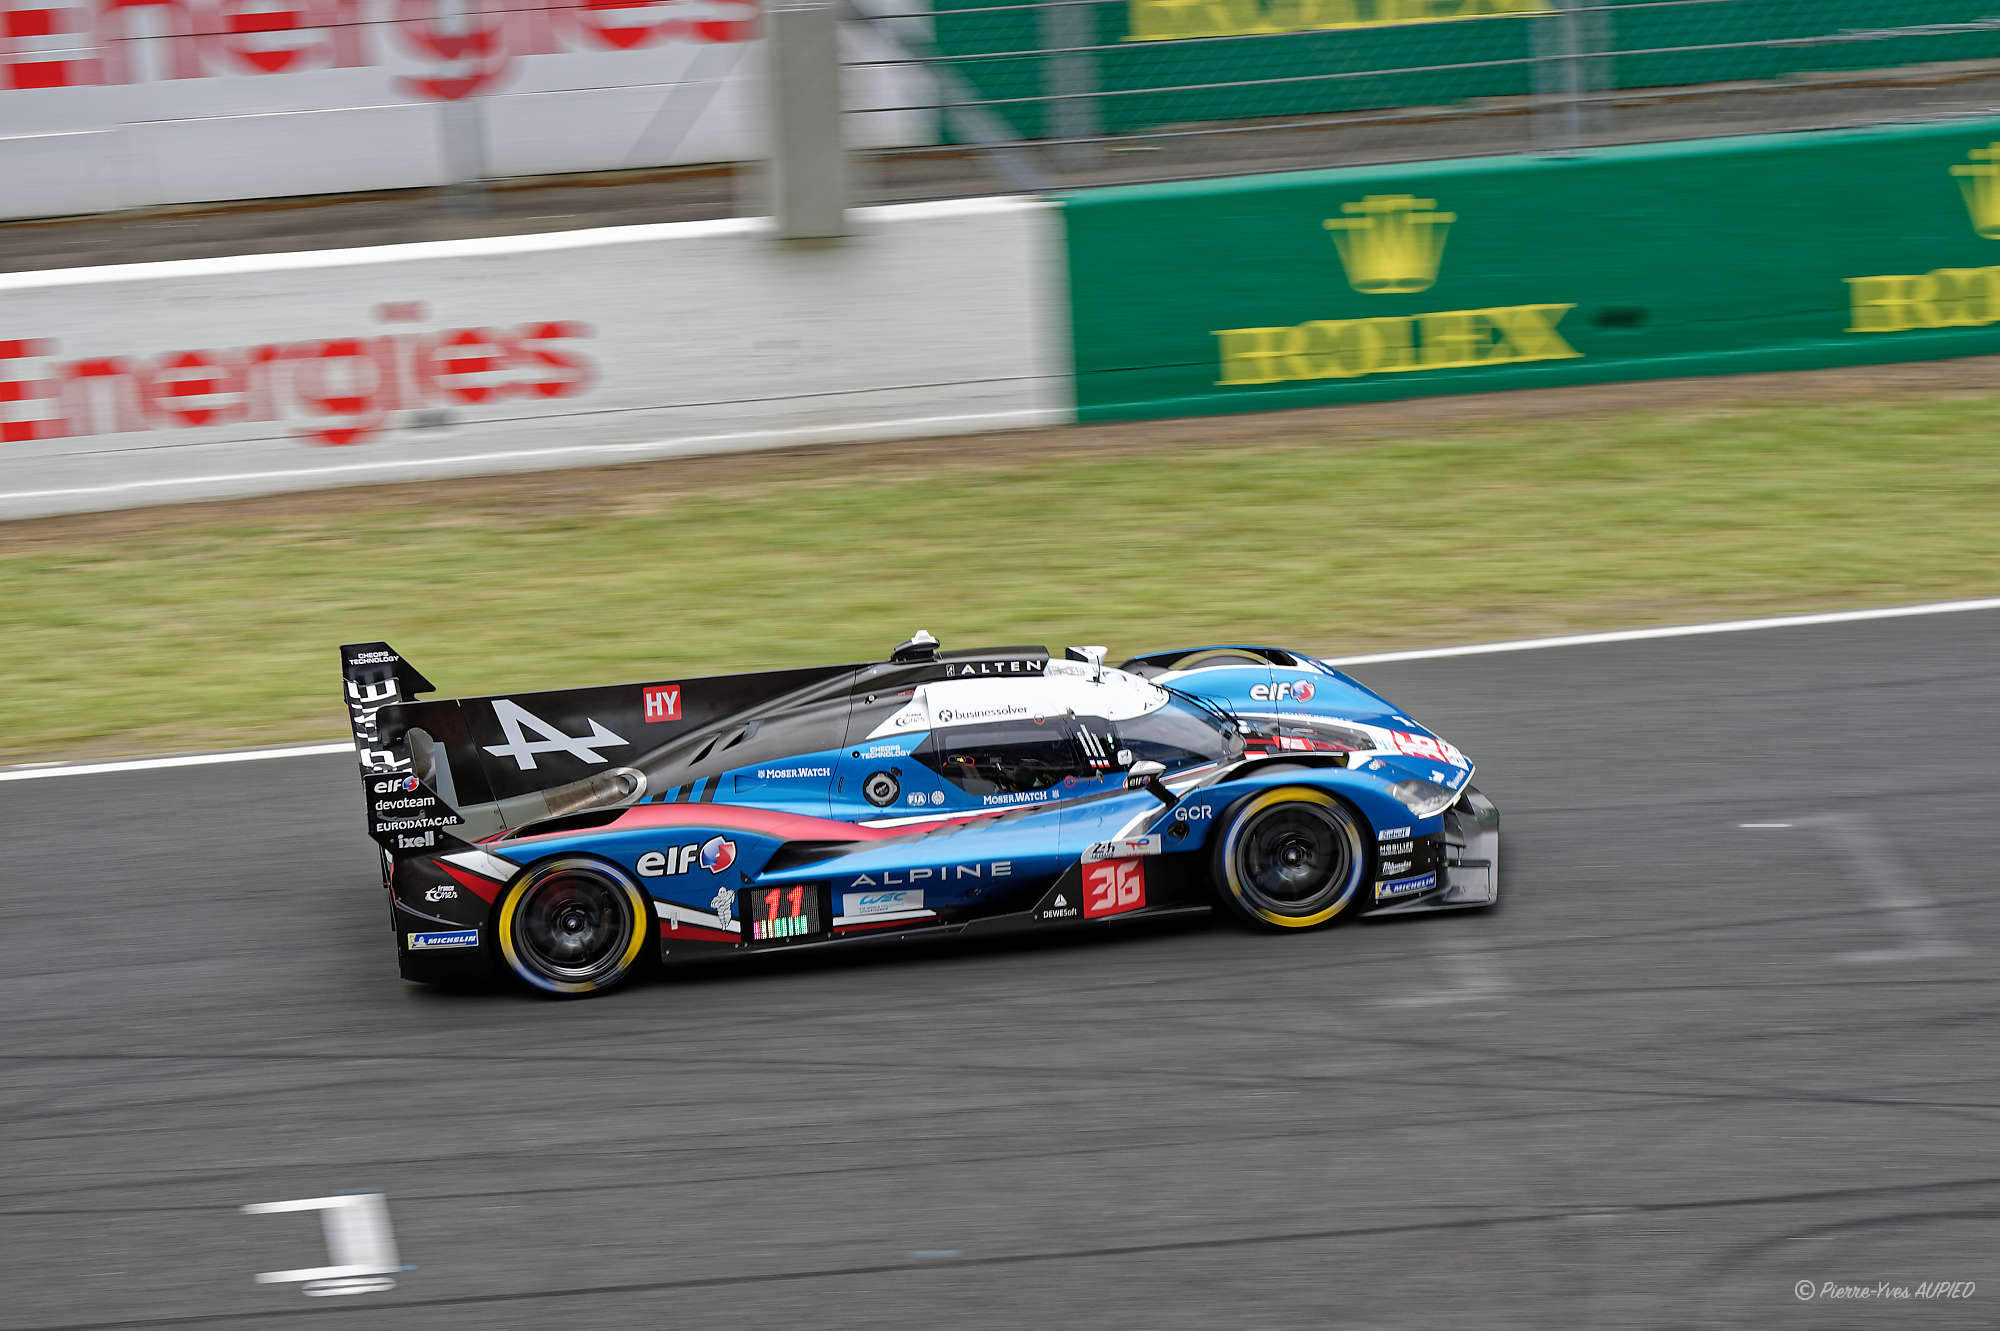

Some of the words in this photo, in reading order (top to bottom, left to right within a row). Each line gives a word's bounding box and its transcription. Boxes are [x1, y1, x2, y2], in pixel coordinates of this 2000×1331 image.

[1209, 303, 1585, 386] ROLEX
[0, 301, 593, 445] Energies
[349, 655, 399, 666] TECHNOLOGY
[358, 651, 389, 659] CHEOPS
[961, 660, 1042, 675] ALTEN
[1250, 682, 1292, 701] elf
[646, 690, 678, 717] HY
[955, 704, 1028, 720] businessolver
[374, 779, 402, 794] elf
[375, 796, 436, 811] devoteam
[1175, 804, 1213, 822] GCR
[376, 815, 458, 832] EURODATACAR
[398, 830, 435, 849] ixell
[636, 844, 699, 877] elf
[850, 861, 1012, 888] ALPINE
[1088, 859, 1141, 911] 36
[1393, 876, 1435, 893] MICHELIN
[764, 885, 804, 921] 11
[1043, 907, 1078, 919] DEWESoft
[427, 935, 477, 945] MICHELIN
